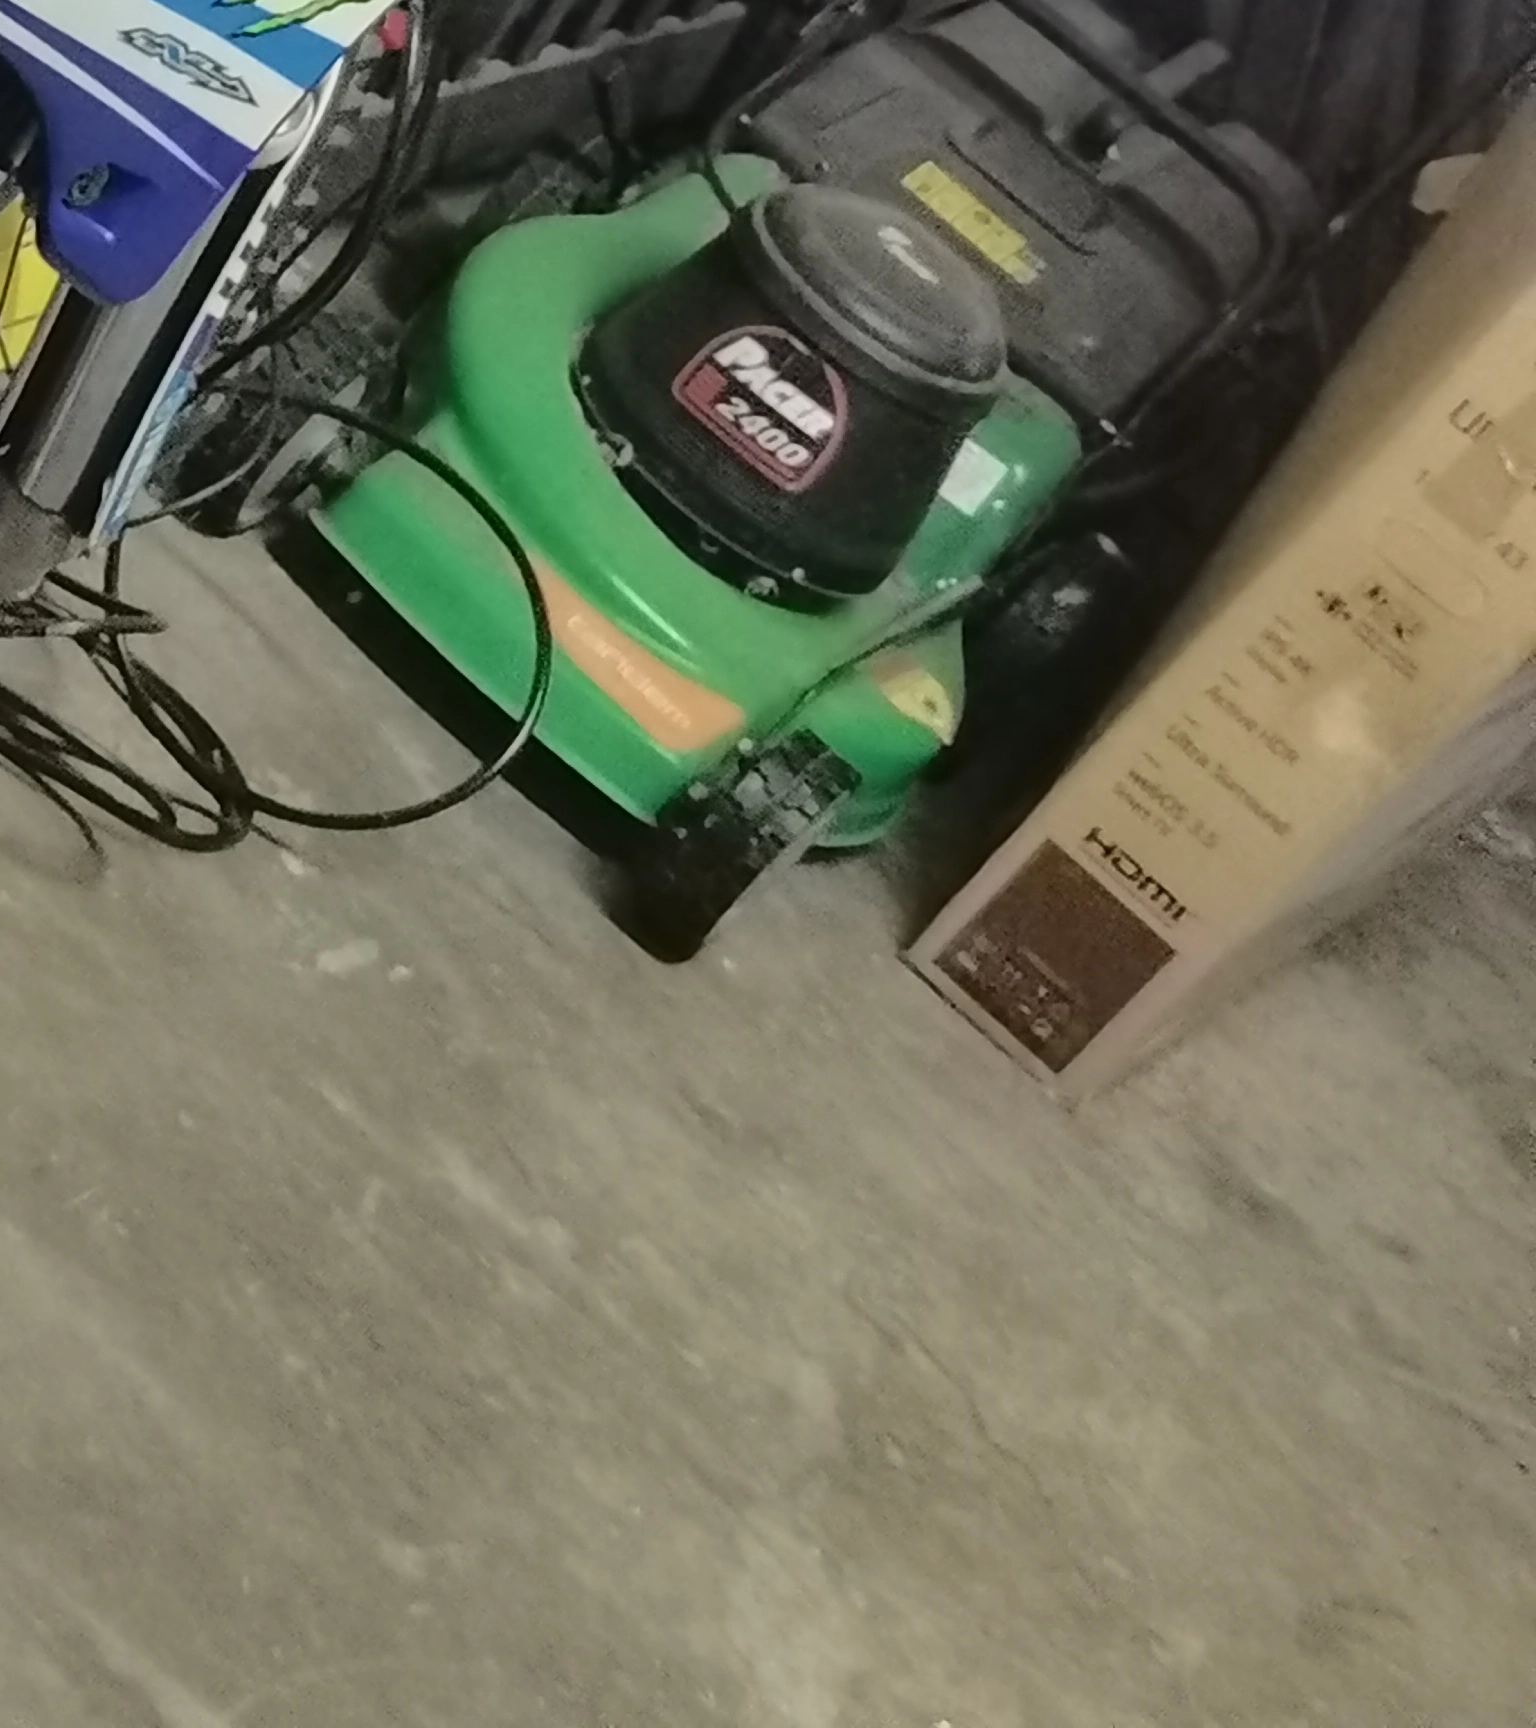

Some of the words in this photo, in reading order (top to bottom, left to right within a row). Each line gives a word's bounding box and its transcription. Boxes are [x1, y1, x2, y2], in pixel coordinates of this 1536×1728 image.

[712, 335, 834, 441] PACER
[714, 396, 813, 467] 2400
[1083, 826, 1187, 922] HDMI
